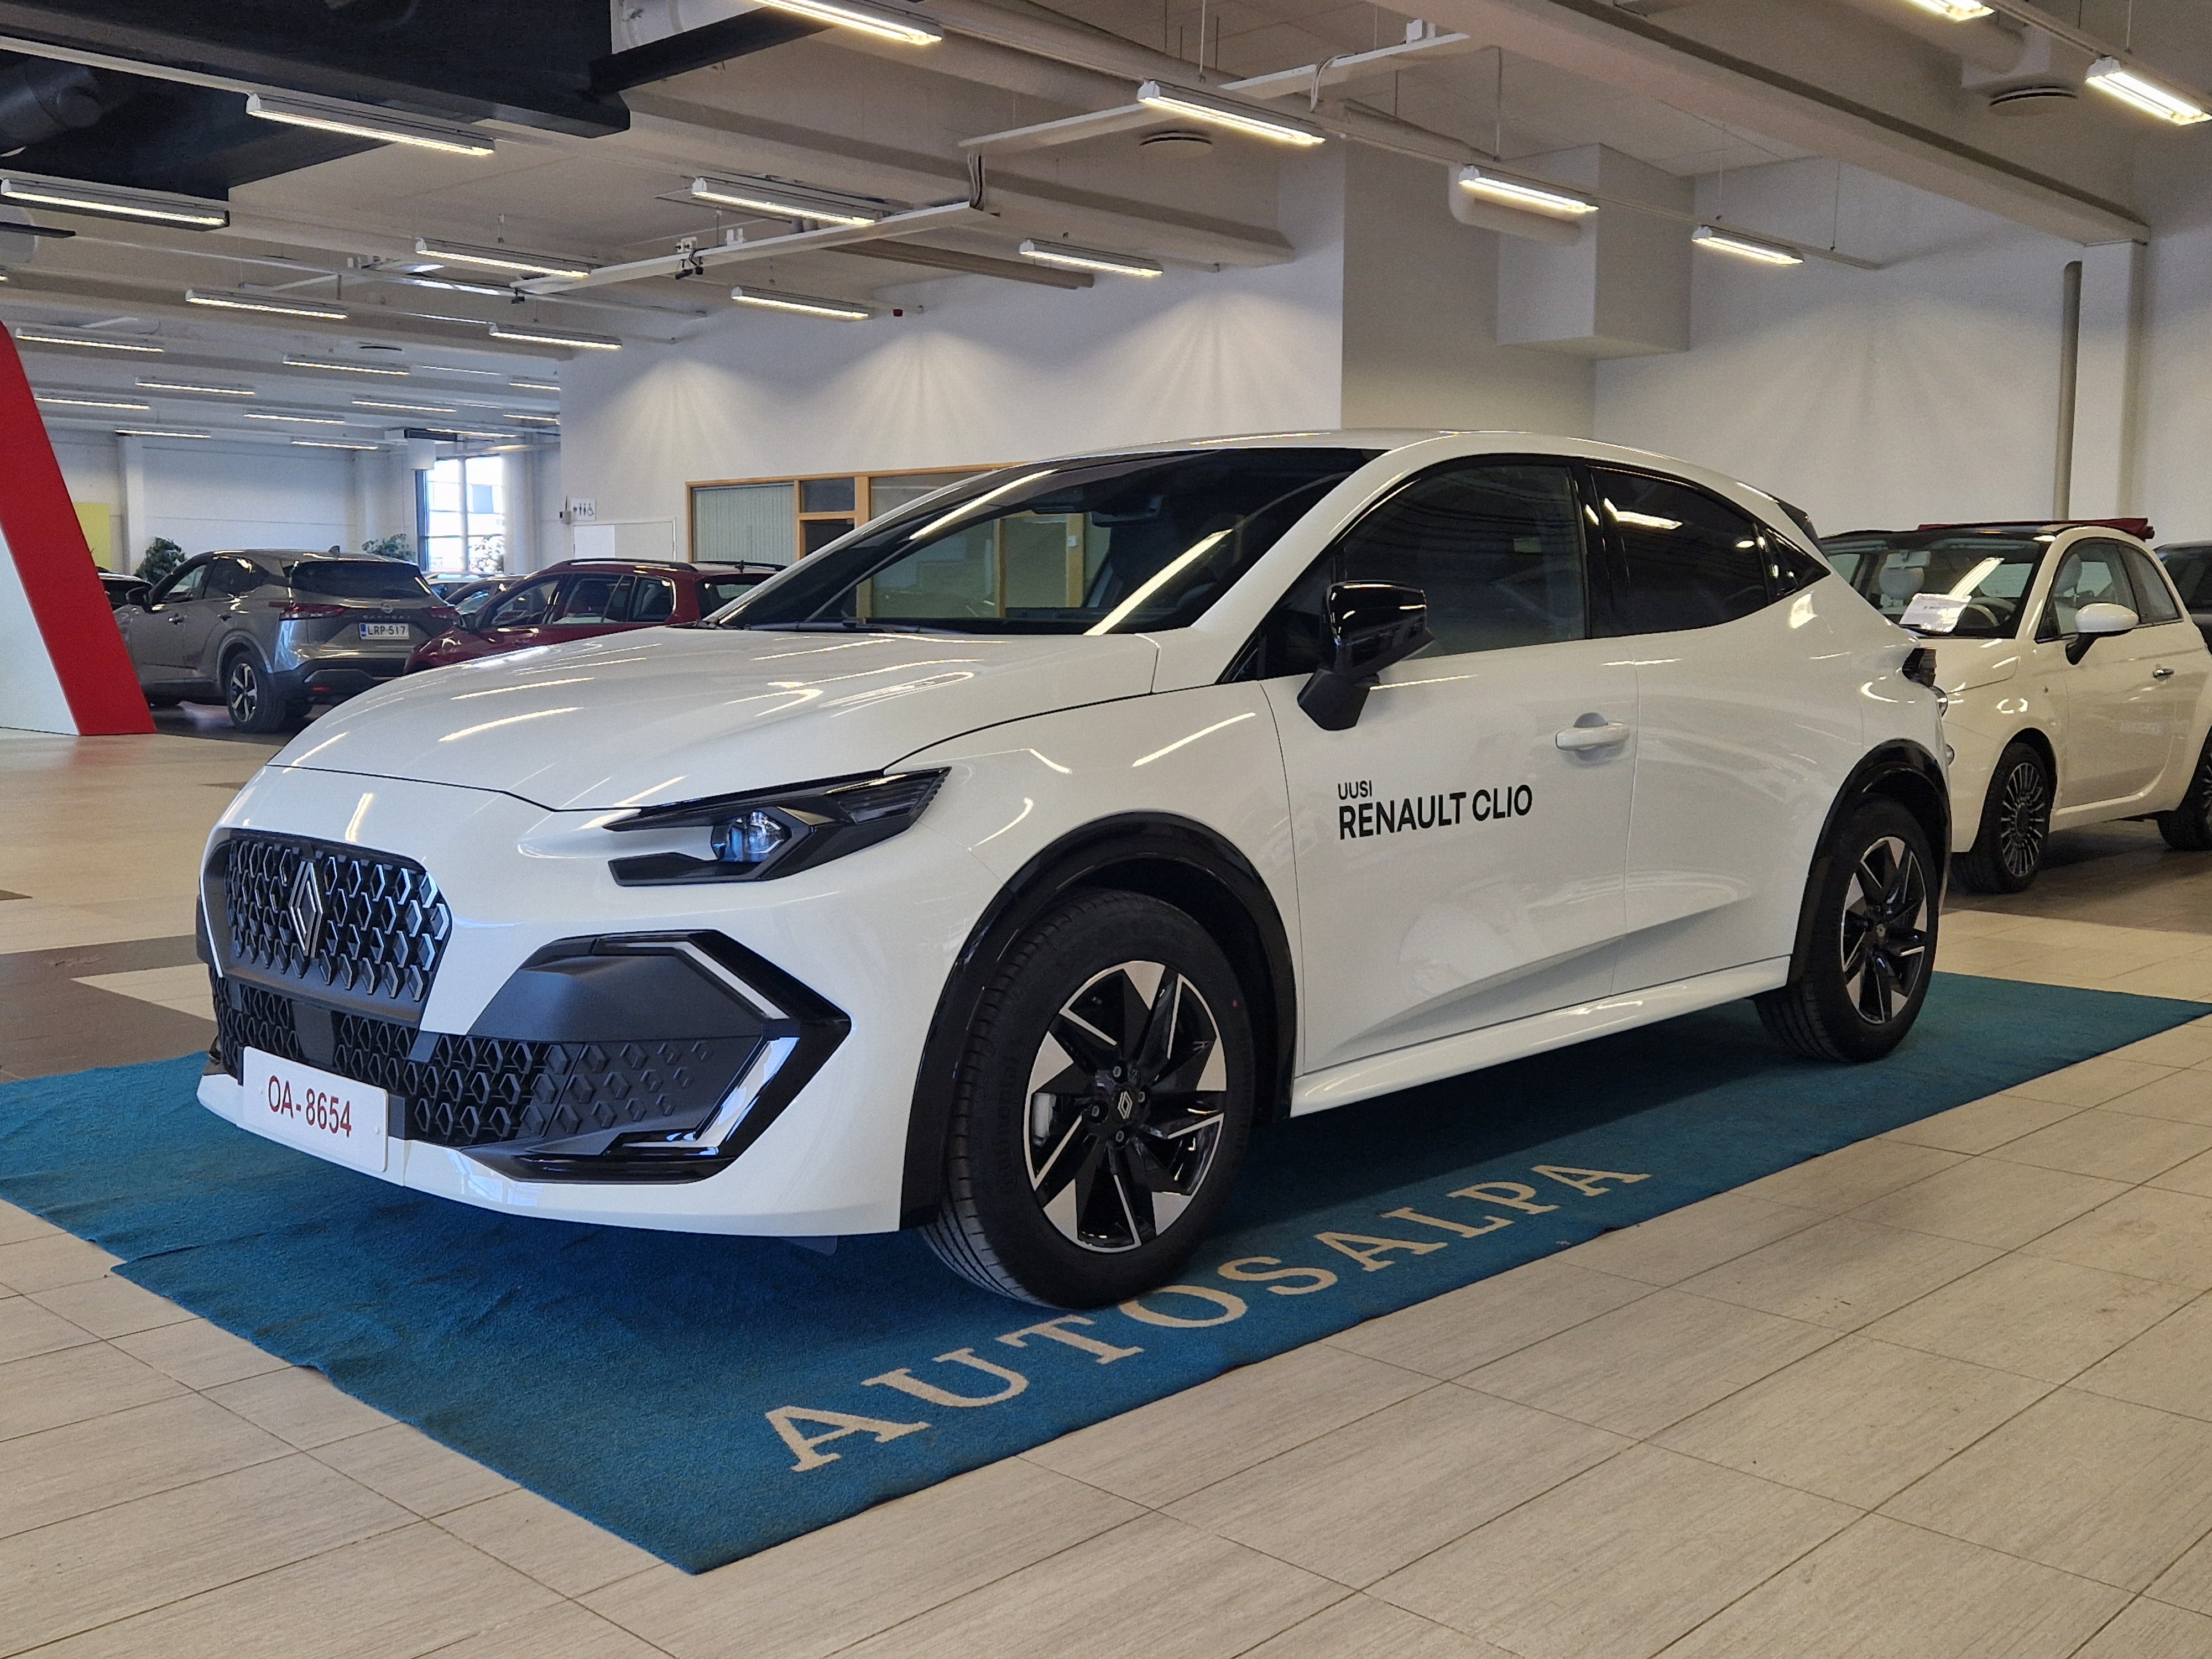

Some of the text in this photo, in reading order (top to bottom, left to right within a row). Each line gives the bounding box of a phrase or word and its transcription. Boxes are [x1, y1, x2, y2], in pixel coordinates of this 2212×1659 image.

[367, 625, 405, 635] LRP-517
[1338, 780, 1372, 800] UUSI
[1339, 785, 1532, 839] RENAULT CLIO
[268, 1075, 352, 1138] OA-8654
[764, 1162, 1652, 1472] AUTOSALPA
